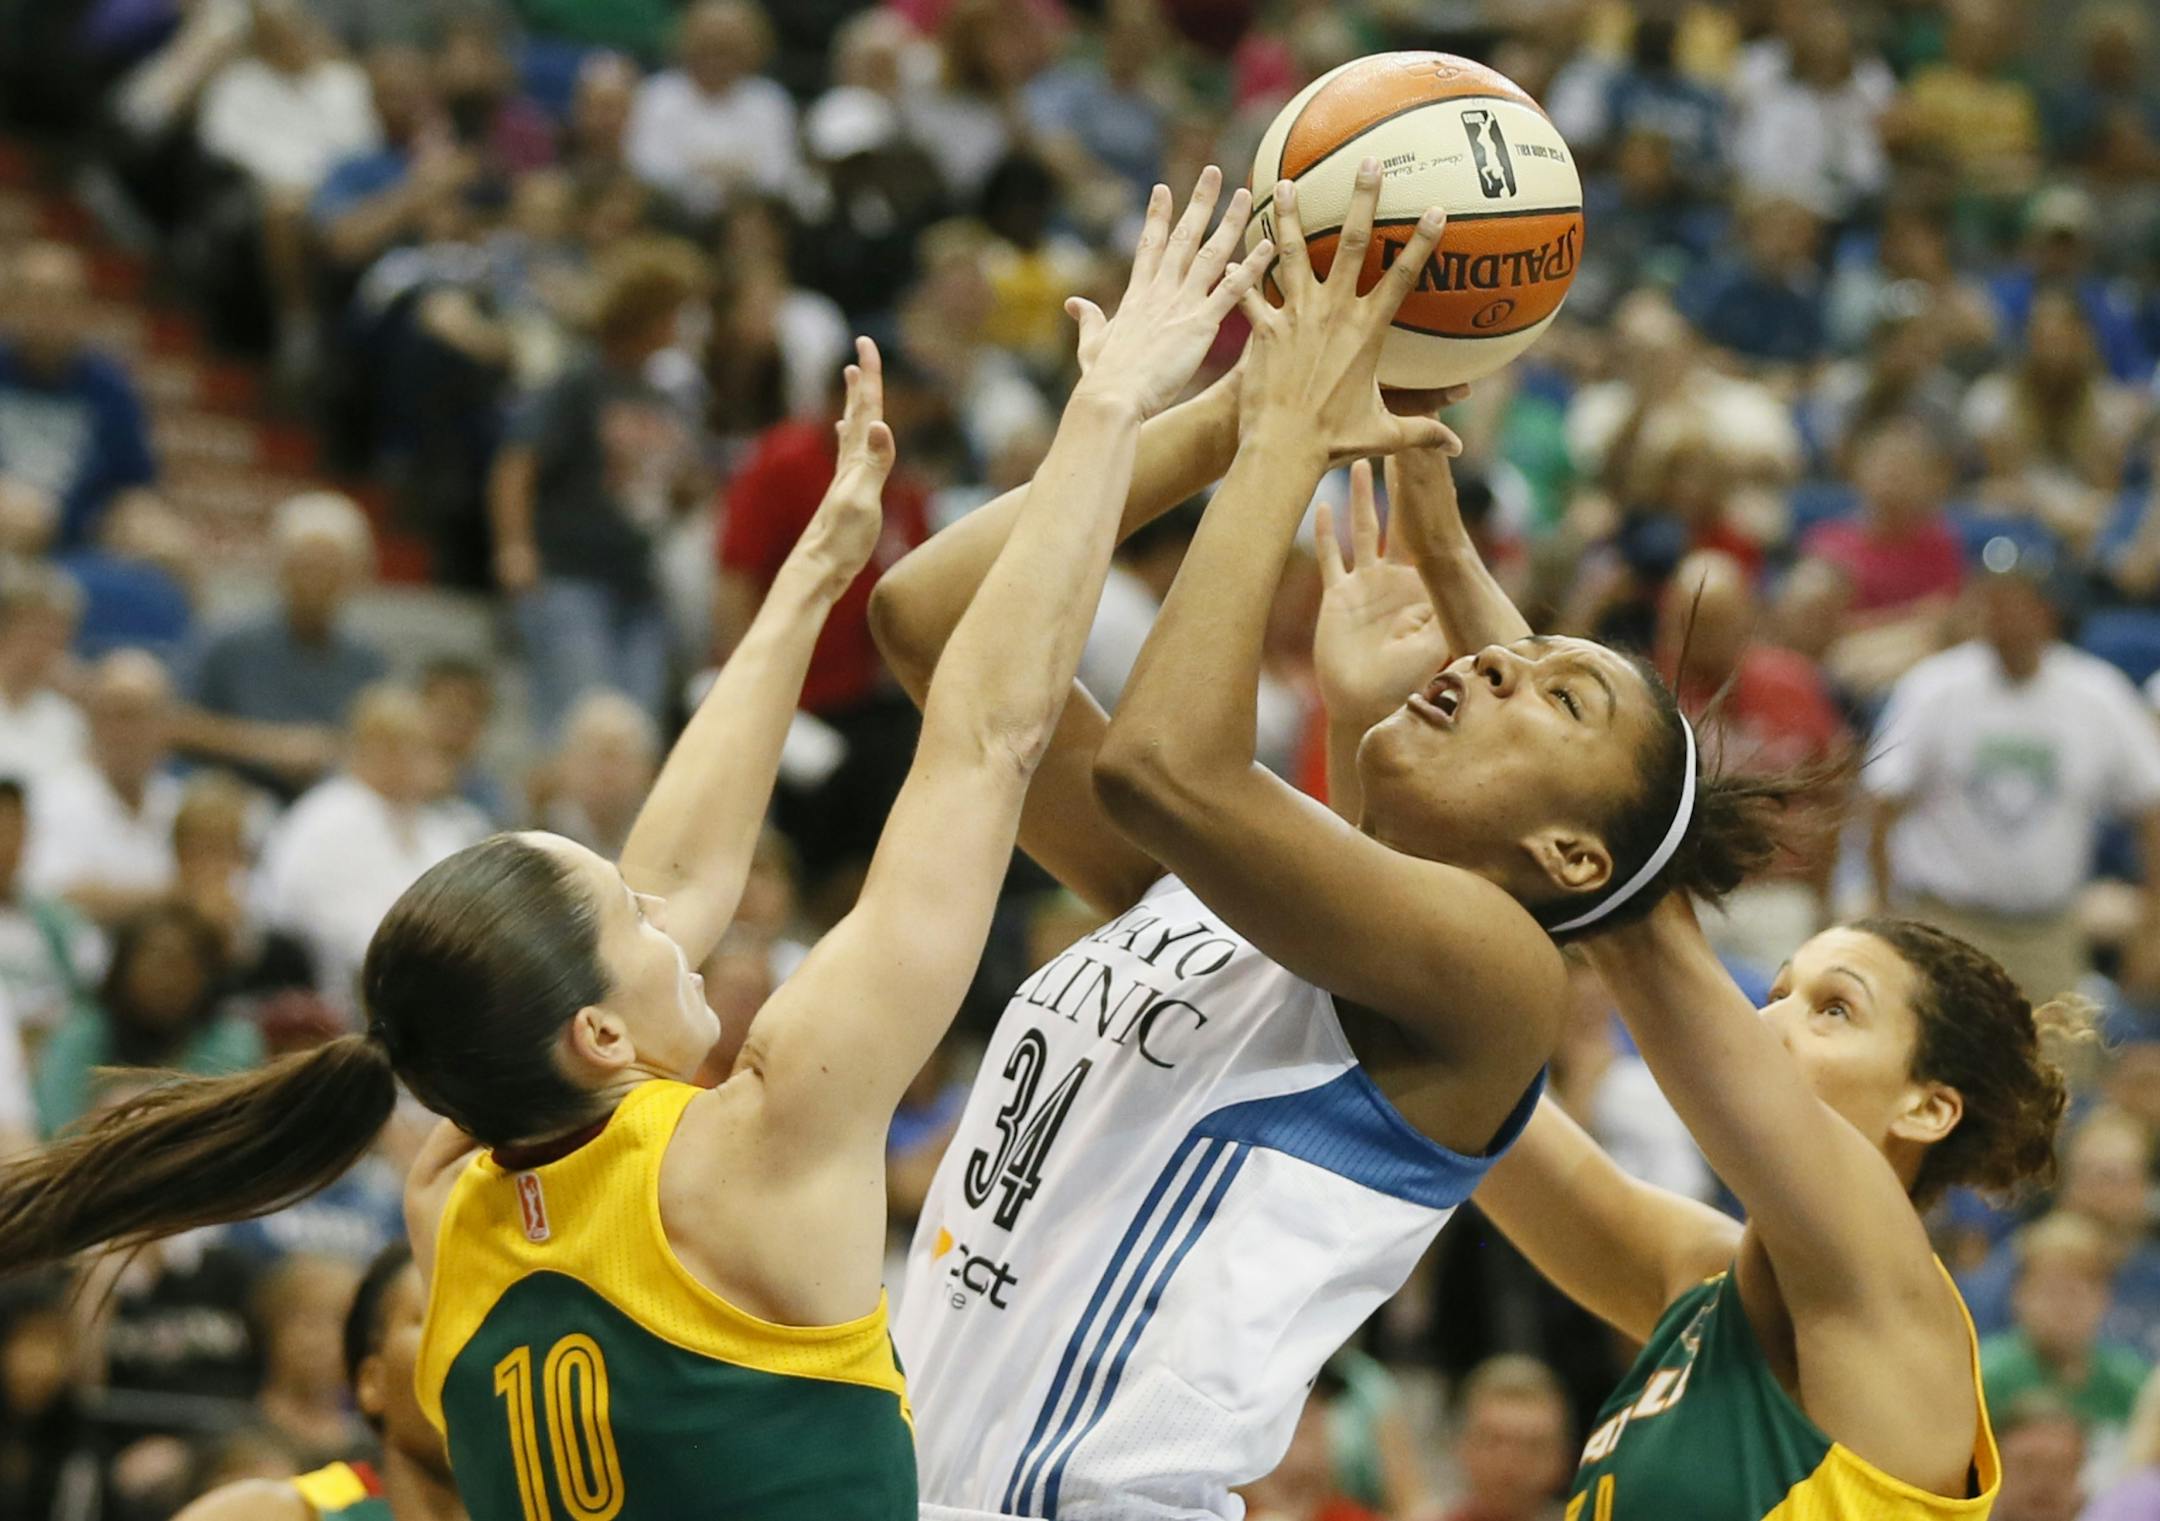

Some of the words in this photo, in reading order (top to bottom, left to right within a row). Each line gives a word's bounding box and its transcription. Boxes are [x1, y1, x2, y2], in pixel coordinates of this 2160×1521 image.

[1014, 953, 1208, 1069] LINIC
[963, 1027, 1093, 1232] 34
[493, 1332, 625, 1521] 10
